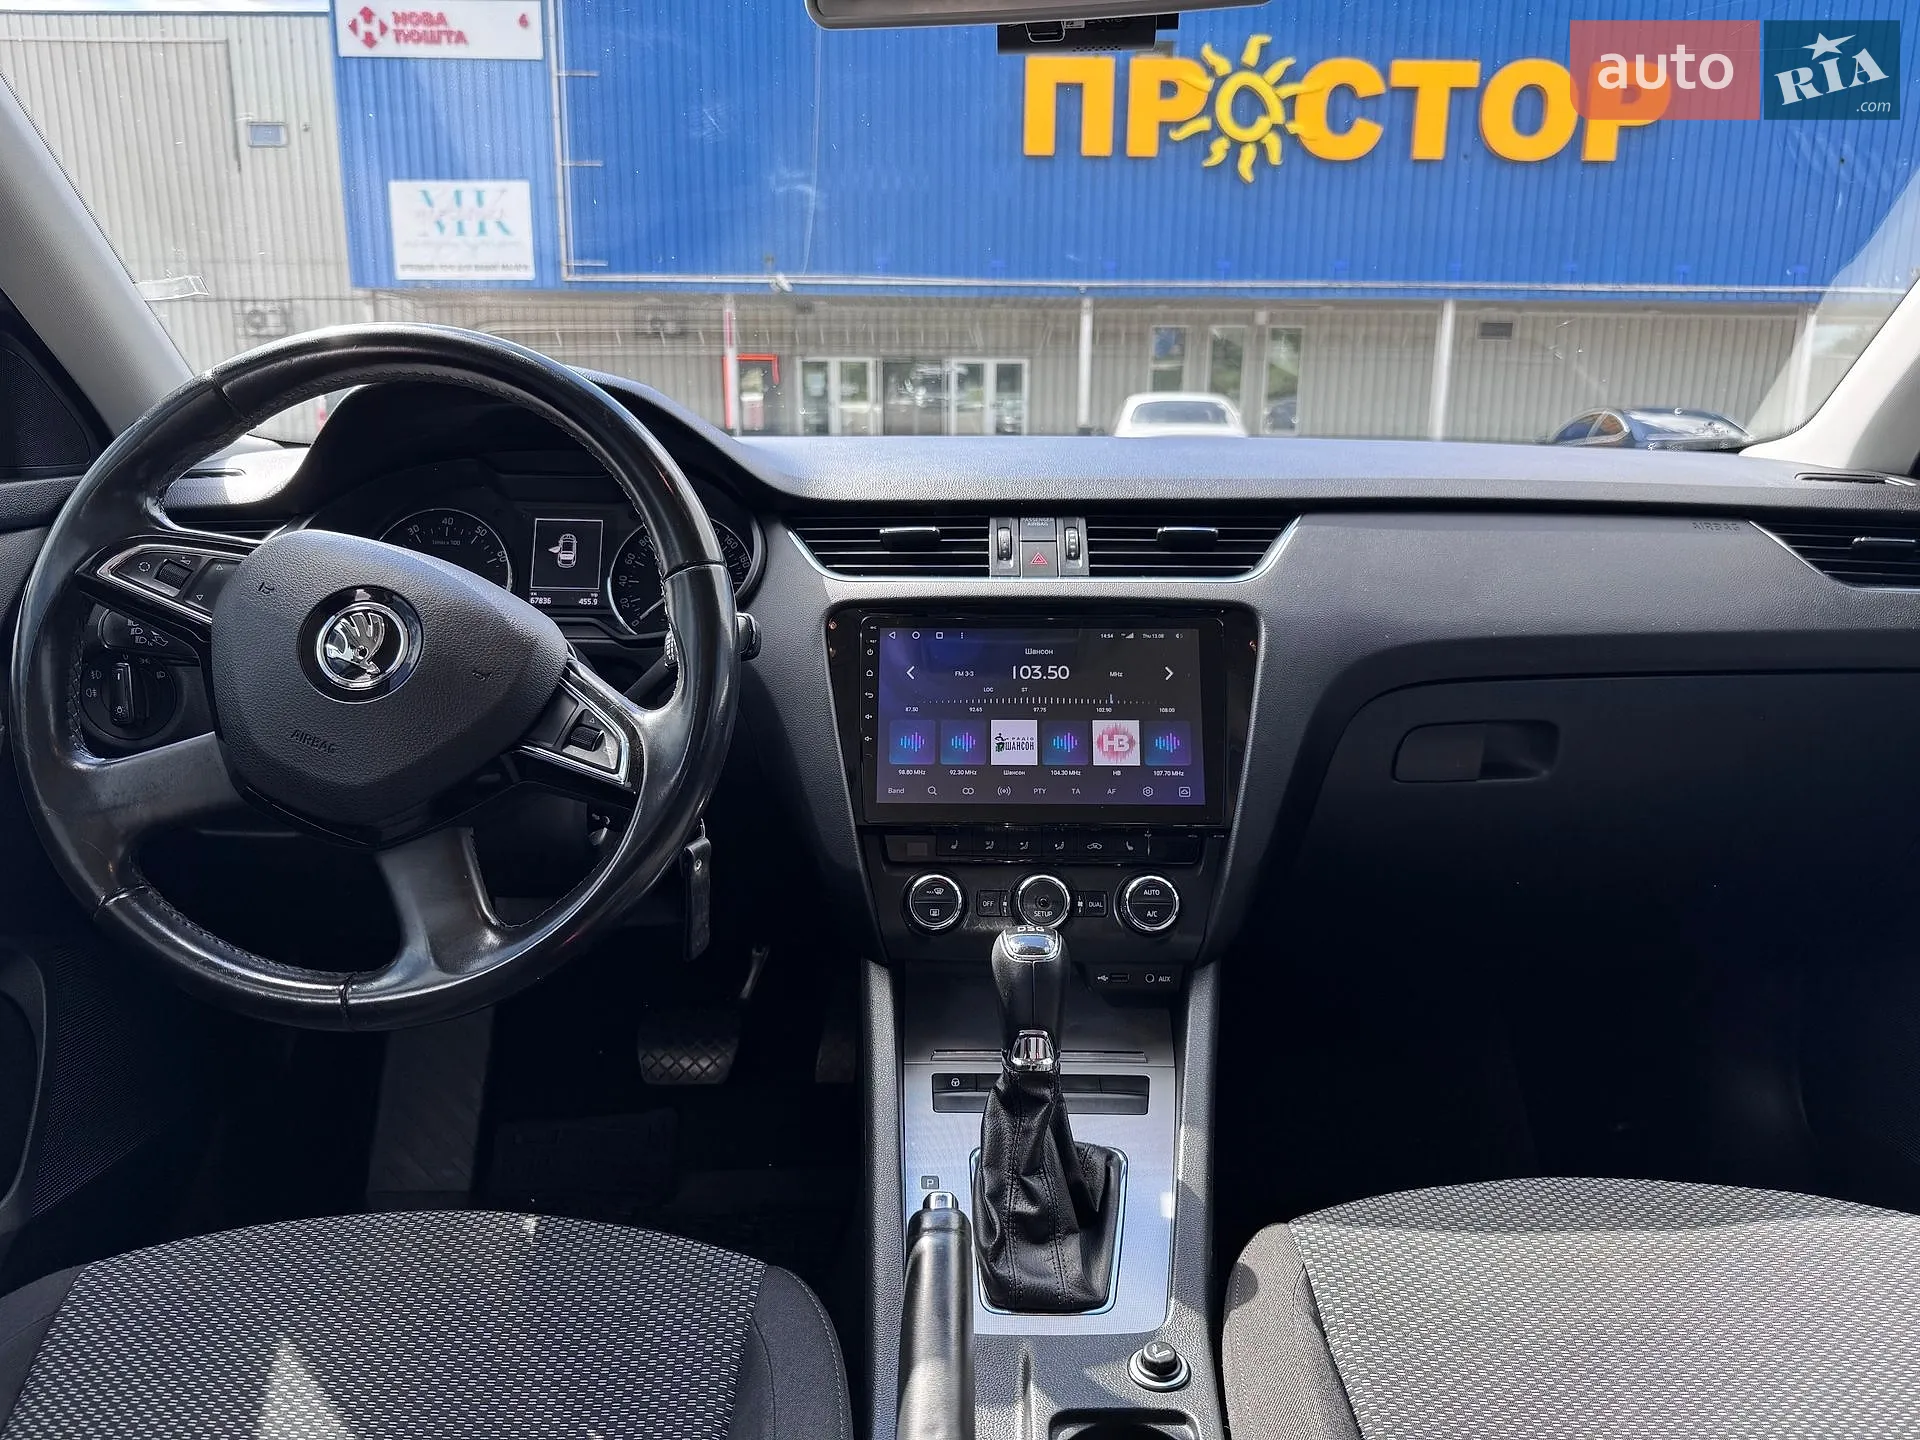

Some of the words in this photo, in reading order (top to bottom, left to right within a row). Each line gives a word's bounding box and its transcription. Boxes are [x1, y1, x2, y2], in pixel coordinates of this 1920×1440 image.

[441, 517, 454, 526] 40
[407, 524, 420, 536] 30
[475, 525, 488, 537] 50
[497, 551, 507, 563] 60
[625, 552, 636, 566] 60
[619, 575, 628, 587] 40
[579, 597, 598, 606] 455.9
[620, 597, 630, 609] 20
[1012, 665, 1070, 680] 103.50
[1005, 740, 1035, 752] ШАНСОН
[1143, 888, 1160, 896] AUTO
[982, 900, 995, 908] OFF
[1088, 900, 1104, 908] DUAL
[1033, 910, 1053, 918] SETUP
[1146, 910, 1158, 918] A/C
[1017, 925, 1045, 933] DSG
[1158, 974, 1172, 983] AUX
